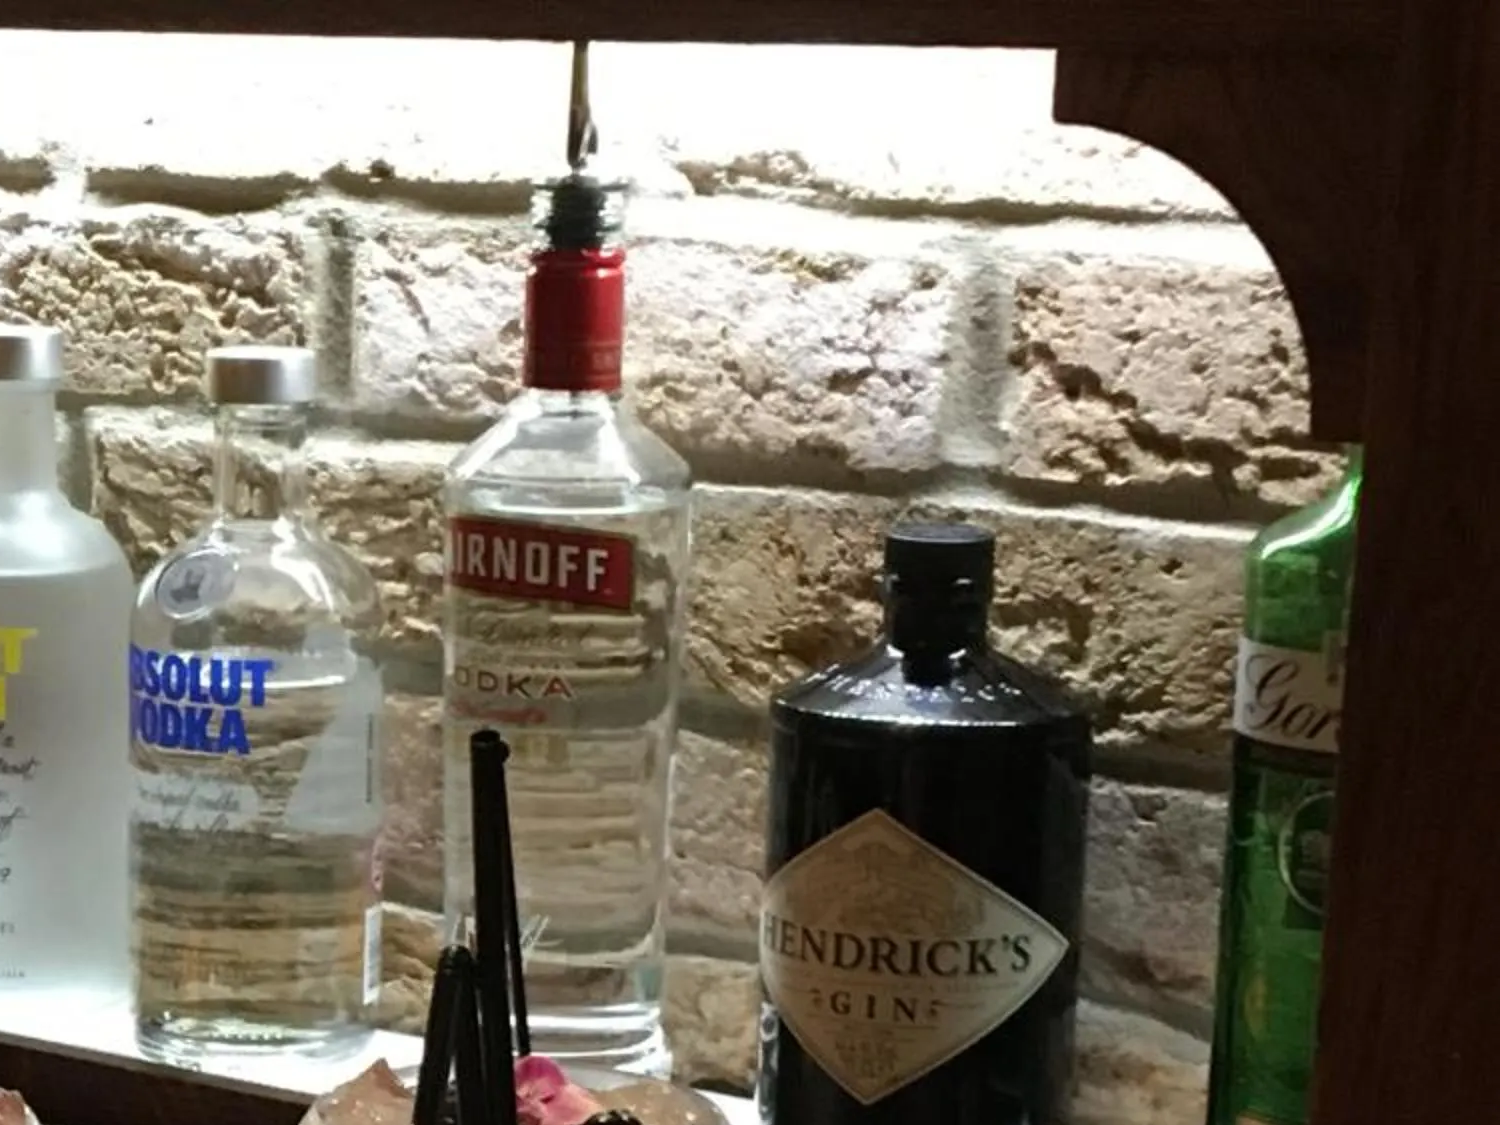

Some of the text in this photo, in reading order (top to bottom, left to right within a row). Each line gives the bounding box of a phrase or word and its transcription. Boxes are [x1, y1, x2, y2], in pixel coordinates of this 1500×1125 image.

[453, 532, 610, 592] IRNOFF
[454, 666, 574, 699] ODKA
[829, 990, 919, 1024] GIN
